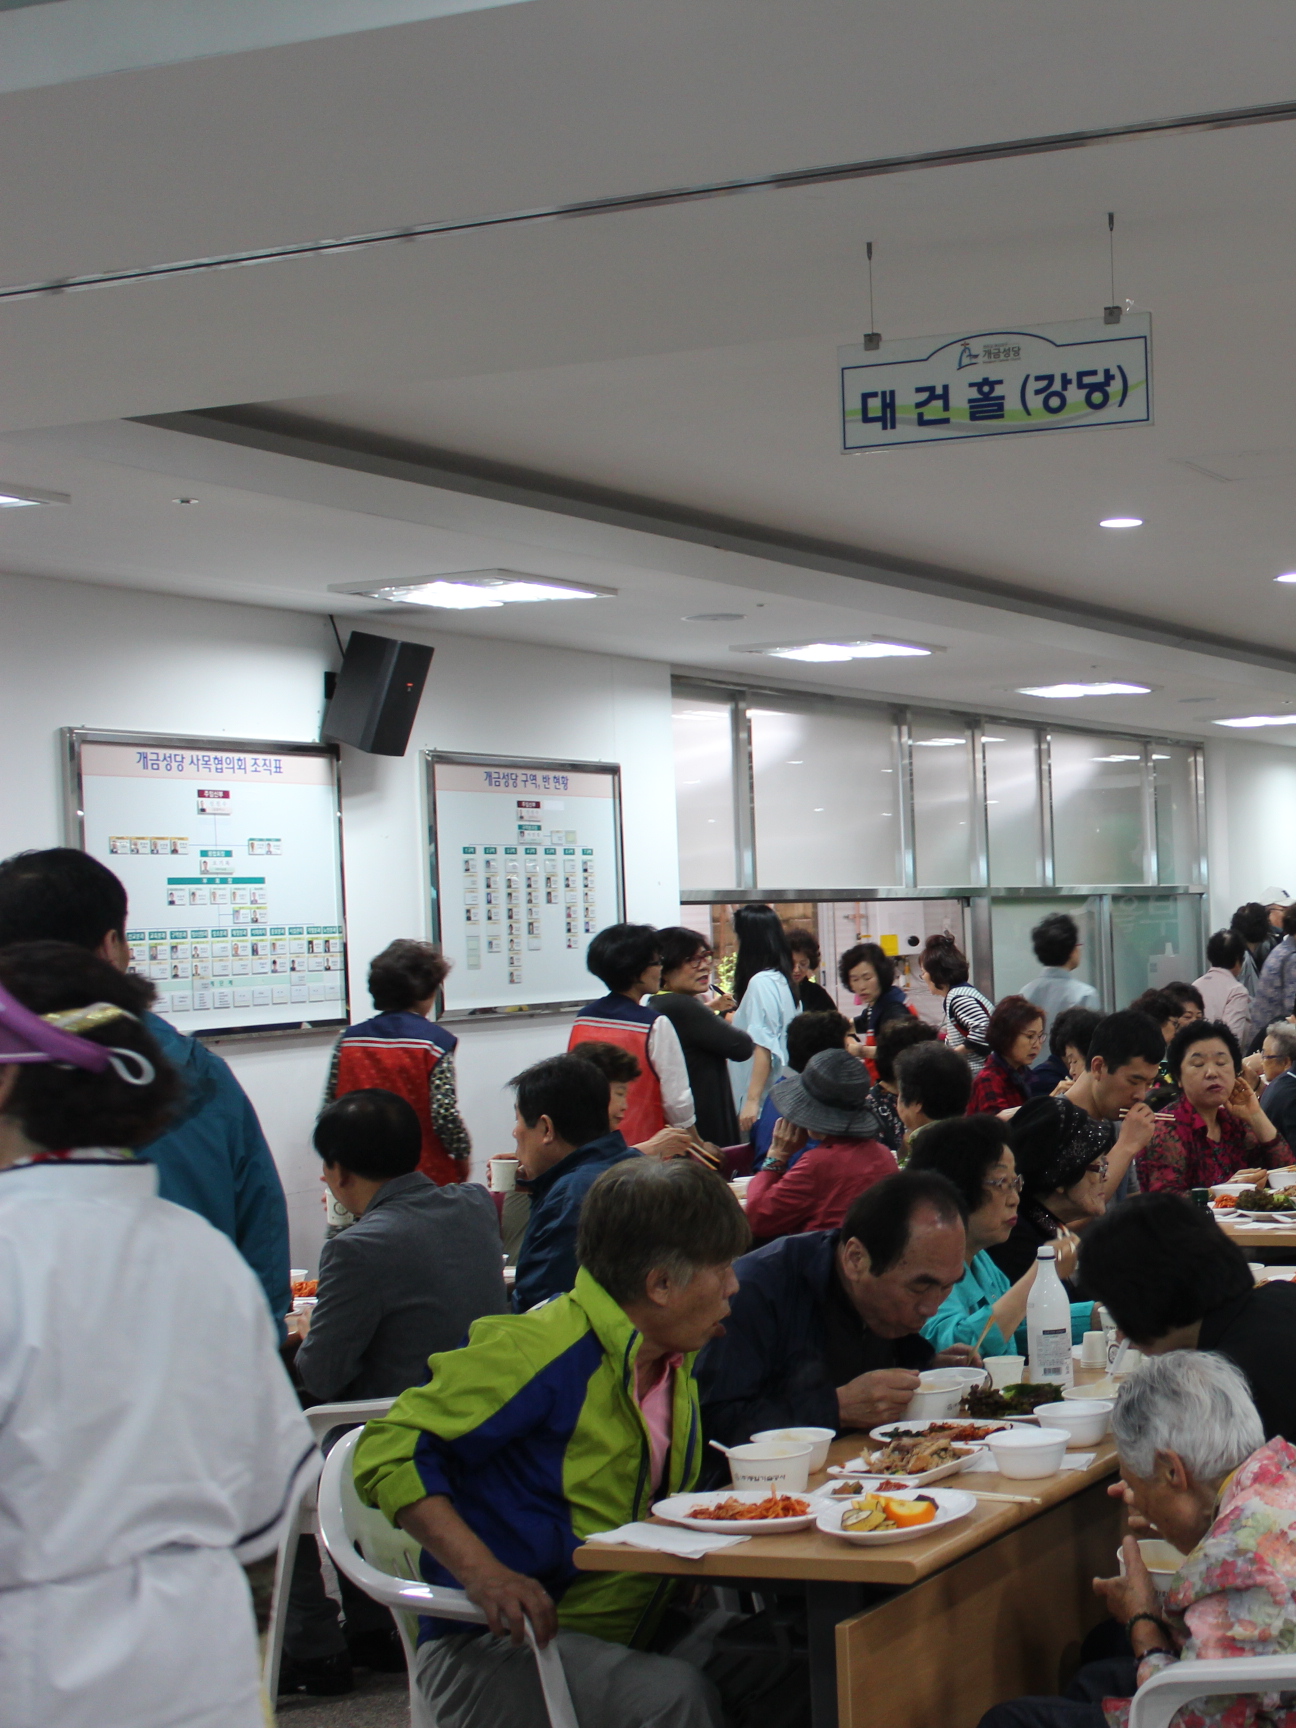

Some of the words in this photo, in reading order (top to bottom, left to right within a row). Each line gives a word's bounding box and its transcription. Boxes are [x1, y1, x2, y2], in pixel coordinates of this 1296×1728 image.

[982, 344, 1021, 360] 개금성당
[1020, 364, 1129, 417] (강당)
[136, 751, 185, 772] 개금성당
[188, 754, 248, 775] 사목협의회
[250, 757, 284, 775] 조직표
[483, 771, 519, 789] 개금성당
[521, 773, 540, 789] 구역,
[542, 774, 551, 790] 반
[552, 775, 569, 791] 현황
